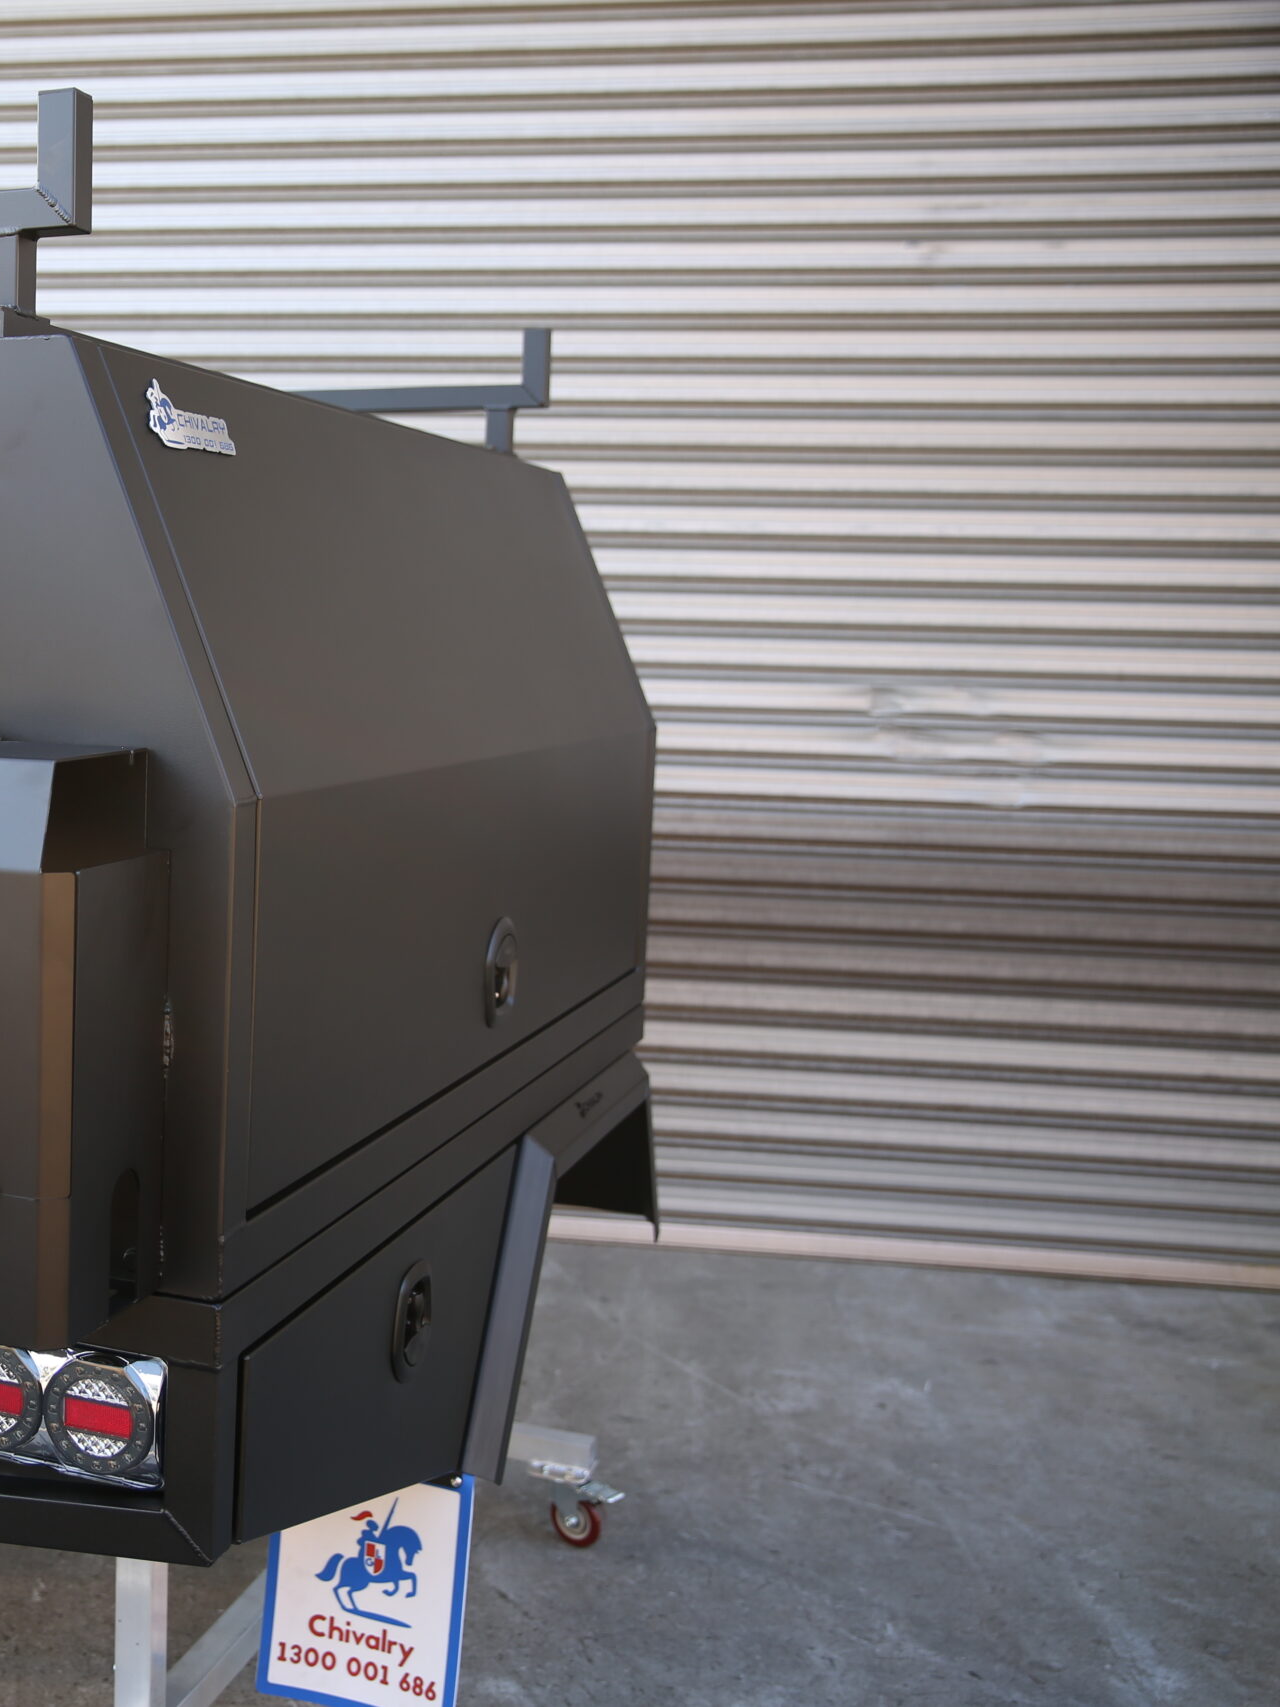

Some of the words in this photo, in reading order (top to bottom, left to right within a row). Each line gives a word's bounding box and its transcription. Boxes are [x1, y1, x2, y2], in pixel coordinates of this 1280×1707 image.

[177, 414, 225, 434] CHIVALRY
[184, 435, 201, 446] 1300
[308, 1614, 415, 1668] Chivalry
[277, 1641, 336, 1671] 1300
[346, 1657, 390, 1686] 001
[399, 1673, 437, 1702] 686
